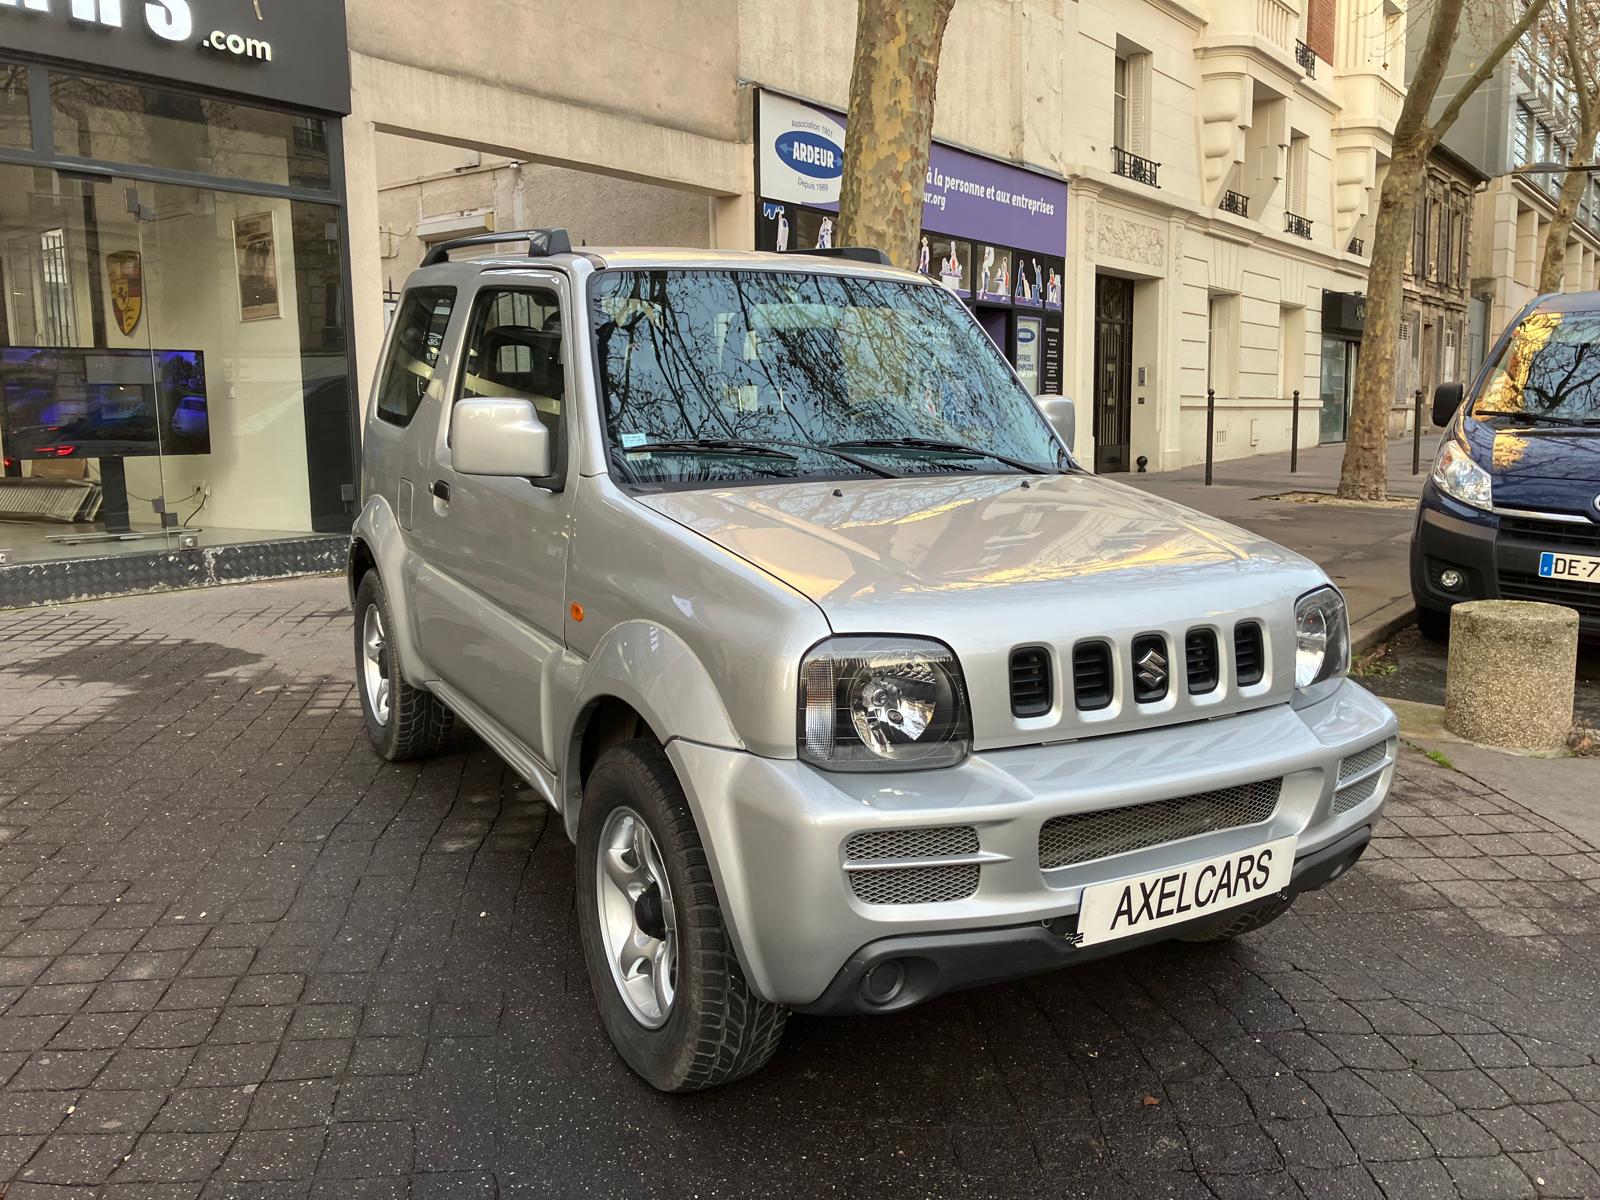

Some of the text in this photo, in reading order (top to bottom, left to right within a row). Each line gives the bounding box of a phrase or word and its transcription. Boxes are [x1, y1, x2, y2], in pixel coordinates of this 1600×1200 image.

[203, 30, 272, 62] .com
[791, 119, 833, 137] Association 1901
[792, 141, 835, 168] ARDEUR
[798, 177, 816, 190] Depuis
[926, 166, 1054, 216] à la personne et aux entreprises
[923, 192, 946, 211] ur.org
[1554, 557, 1600, 578] DE-7
[1109, 849, 1273, 931] AXELCARS
